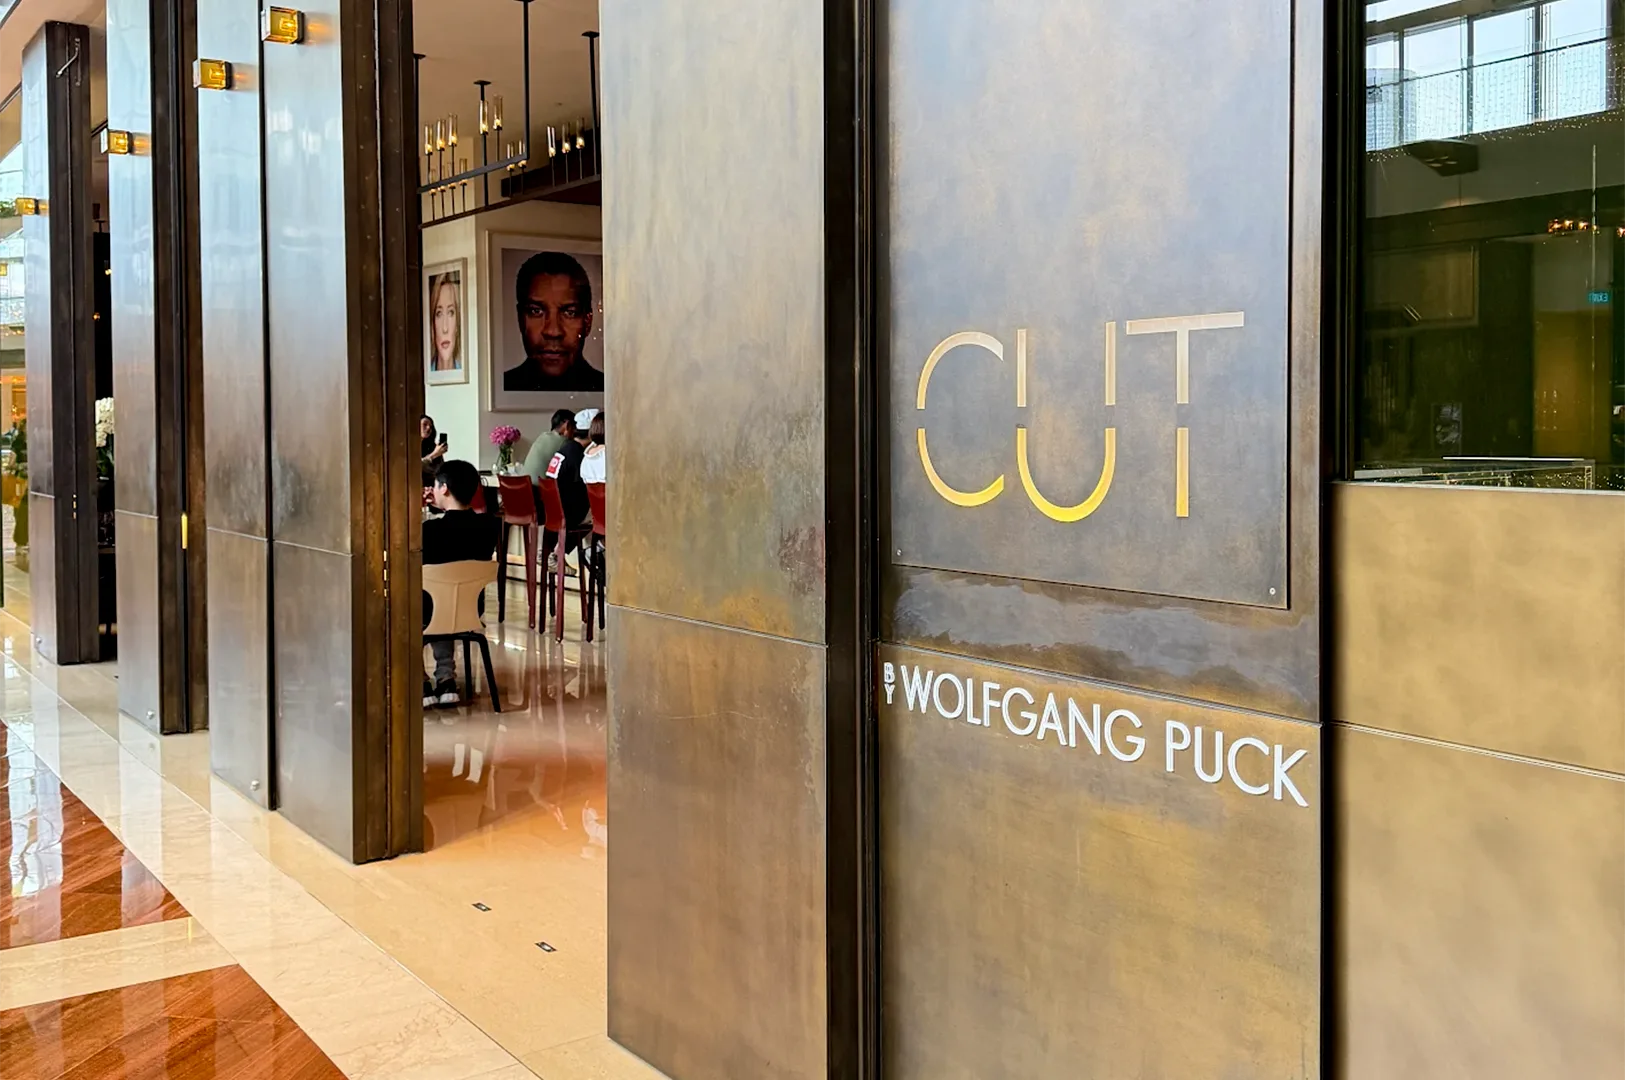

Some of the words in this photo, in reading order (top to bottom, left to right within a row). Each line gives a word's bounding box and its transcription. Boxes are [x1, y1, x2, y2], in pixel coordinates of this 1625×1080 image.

[917, 311, 1244, 522] CUT
[883, 661, 896, 705] BY
[900, 664, 1147, 762] WOLFGANG
[1164, 720, 1309, 807] PUCK
